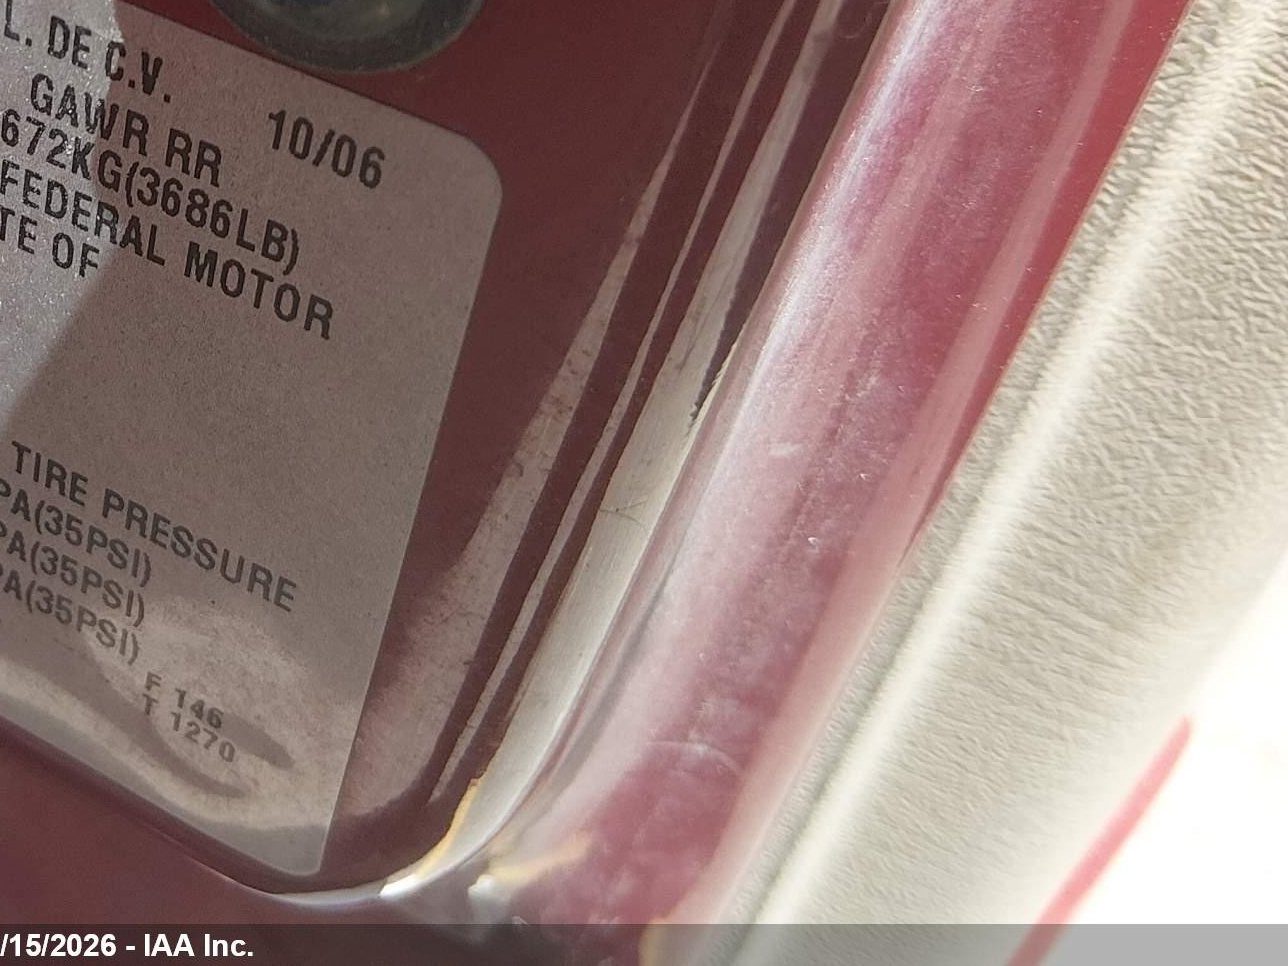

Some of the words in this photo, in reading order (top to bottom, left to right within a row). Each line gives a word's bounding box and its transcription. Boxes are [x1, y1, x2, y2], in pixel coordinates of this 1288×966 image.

[49, 16, 91, 69] DE
[106, 42, 170, 102] C.V.
[31, 73, 148, 157] GAWR
[166, 127, 222, 187] RR
[268, 109, 385, 190] 10/06
[0, 159, 165, 267] FEDERAL
[183, 241, 334, 340] MOTOR
[51, 233, 99, 278] OF
[12, 440, 88, 505] TIRE
[103, 488, 297, 613] PRESSURE
[141, 694, 159, 716] T
